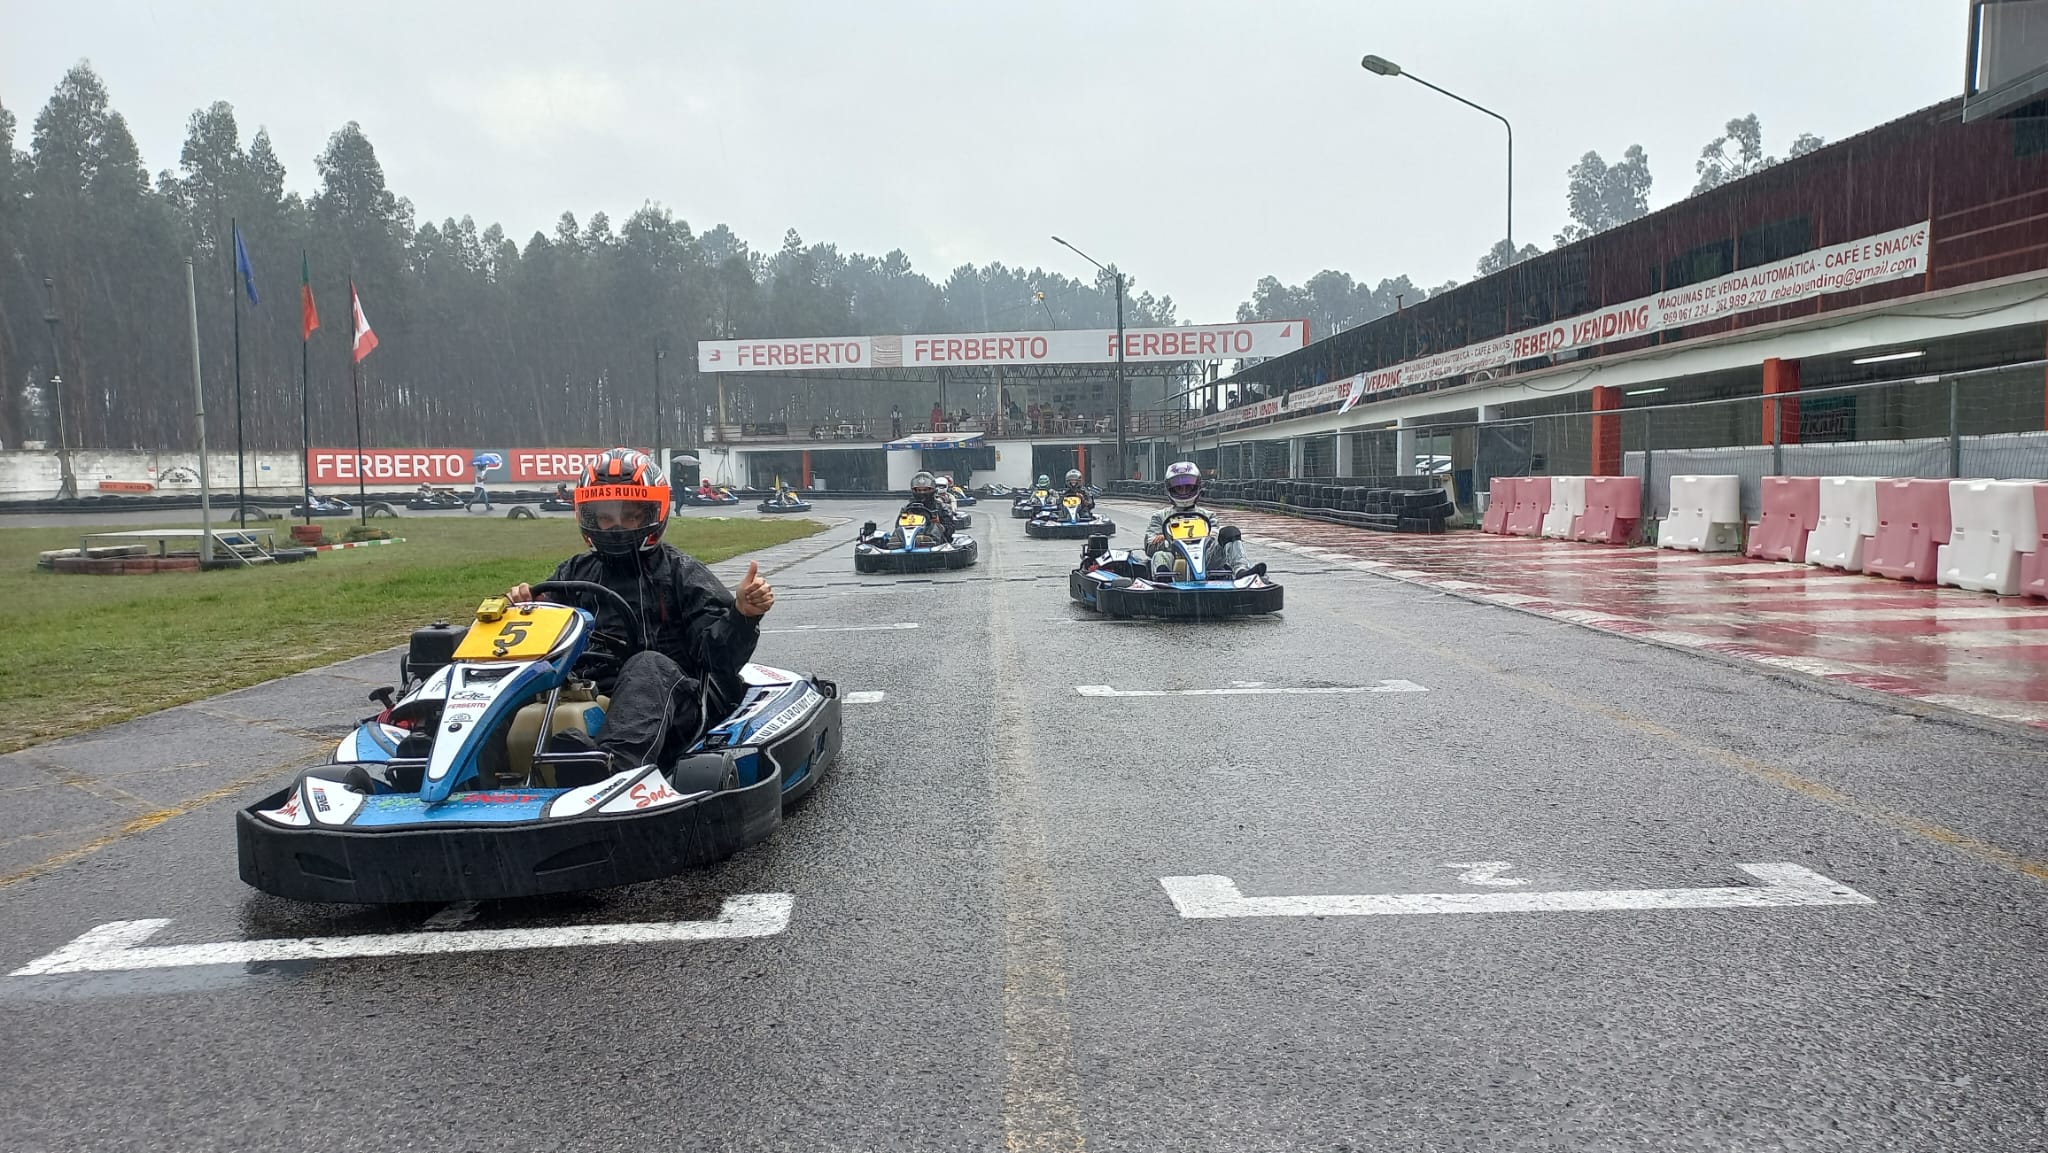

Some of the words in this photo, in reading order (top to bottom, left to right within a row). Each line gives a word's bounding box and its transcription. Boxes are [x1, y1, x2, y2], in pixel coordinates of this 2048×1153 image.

[1705, 285, 1717, 299] DE
[1718, 277, 1749, 296] VENDA
[1751, 259, 1816, 287] AUTOMÁTICA
[1825, 244, 1859, 268] CAFÉ
[1863, 245, 1871, 260] E
[1874, 231, 1925, 258] SNACKS
[1663, 311, 1678, 324] 969
[1678, 307, 1692, 320] 061
[1729, 293, 1747, 308] 989
[1748, 289, 1767, 304] 270
[1572, 305, 1649, 345] VENDING
[738, 342, 861, 366] FERBERTO
[915, 336, 1048, 361] FERBERTO
[1108, 329, 1253, 357] FERBERTO
[316, 454, 464, 477] FERBERTO
[581, 487, 612, 500] TOMAS
[615, 487, 648, 498] RUIVO
[1183, 525, 1195, 538] 7
[493, 621, 533, 648] 5
